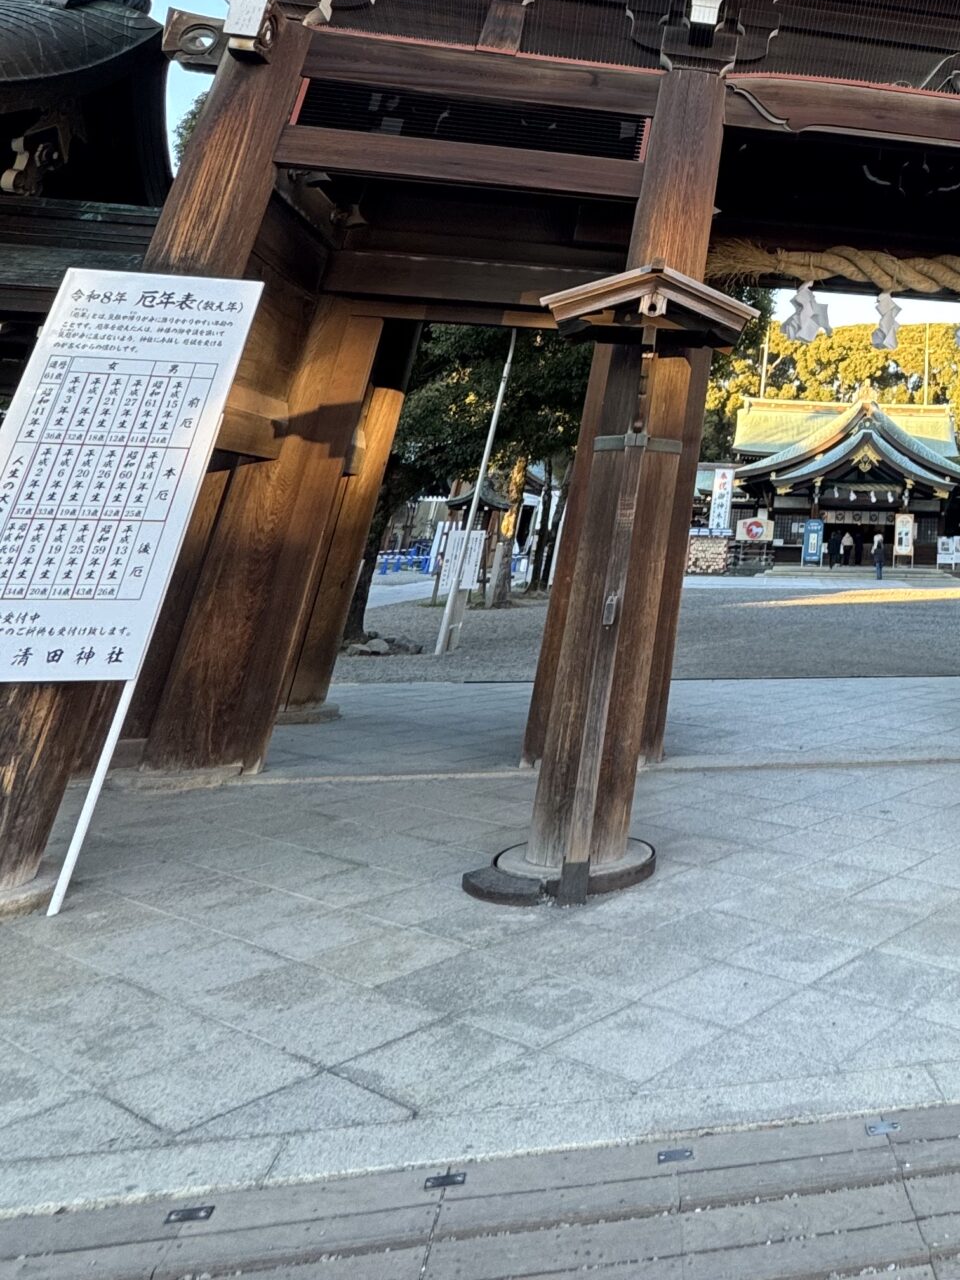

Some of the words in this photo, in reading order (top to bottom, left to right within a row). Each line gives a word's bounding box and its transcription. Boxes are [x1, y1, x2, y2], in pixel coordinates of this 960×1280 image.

[70, 289, 127, 304] 令和8年
[43, 372, 63, 381] 61歳
[107, 363, 116, 371] 女
[168, 364, 180, 374] 男
[54, 373, 81, 426] 平成3年生
[75, 374, 102, 428] 平成7年生
[97, 374, 123, 428] 平成21年生
[117, 376, 143, 429] 平成27年生
[138, 374, 164, 430] 昭和61年生
[159, 376, 184, 430] 平成15年生
[180, 396, 199, 429] 前厄
[24, 387, 53, 439] 昭和41年生
[44, 432, 62, 441] 36歳
[67, 432, 83, 441] 32歳
[88, 433, 105, 442] 18歳
[108, 433, 125, 442] 12歳
[129, 434, 146, 443] 41歳
[150, 435, 167, 444] 24歳
[24, 447, 53, 501] 平成2年生
[47, 448, 74, 502] 平成6年生
[68, 449, 96, 502] 平成20年生
[90, 450, 117, 502] 平成26年生
[112, 451, 138, 503] 昭和60年生
[133, 451, 159, 504] 平成14年生
[155, 467, 176, 501] 本厄
[14, 508, 32, 516] 37歳
[36, 508, 54, 516] 33歳
[81, 509, 98, 517] 13歳
[124, 510, 142, 518] 25歳
[16, 523, 46, 579] 平成5年生
[39, 523, 68, 579] 平成19年生
[62, 524, 90, 579] 平成25年生
[85, 524, 112, 579] 昭和59年生
[107, 525, 134, 579] 平成13年生
[129, 542, 151, 578] 後厄
[6, 588, 24, 596] 34歳
[29, 588, 47, 596] 20歳
[52, 588, 70, 596] 14歳
[75, 588, 93, 596] 43歳
[97, 588, 115, 596] 26歳
[0, 612, 40, 624] 受付中
[11, 646, 125, 666] 清田神社
